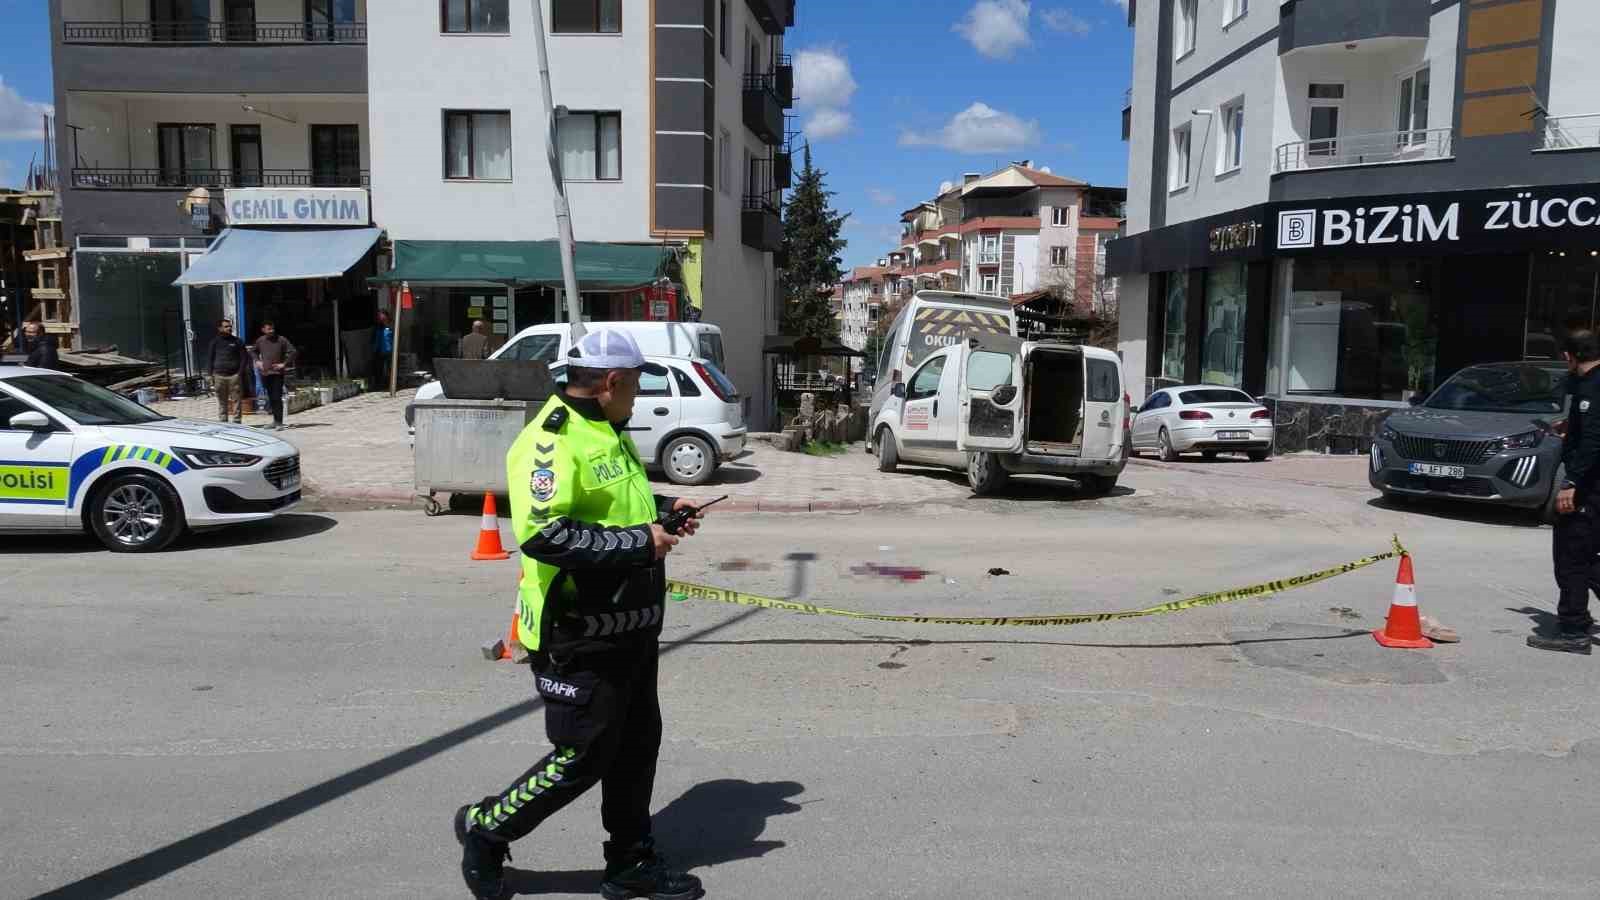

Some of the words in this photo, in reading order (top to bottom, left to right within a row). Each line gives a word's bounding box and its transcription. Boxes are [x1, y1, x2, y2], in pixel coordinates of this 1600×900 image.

[231, 195, 288, 220] CEMİL
[293, 194, 360, 220] GİYİM
[1483, 191, 1600, 229] ZÜCC
[0, 470, 54, 489] OLİSİ
